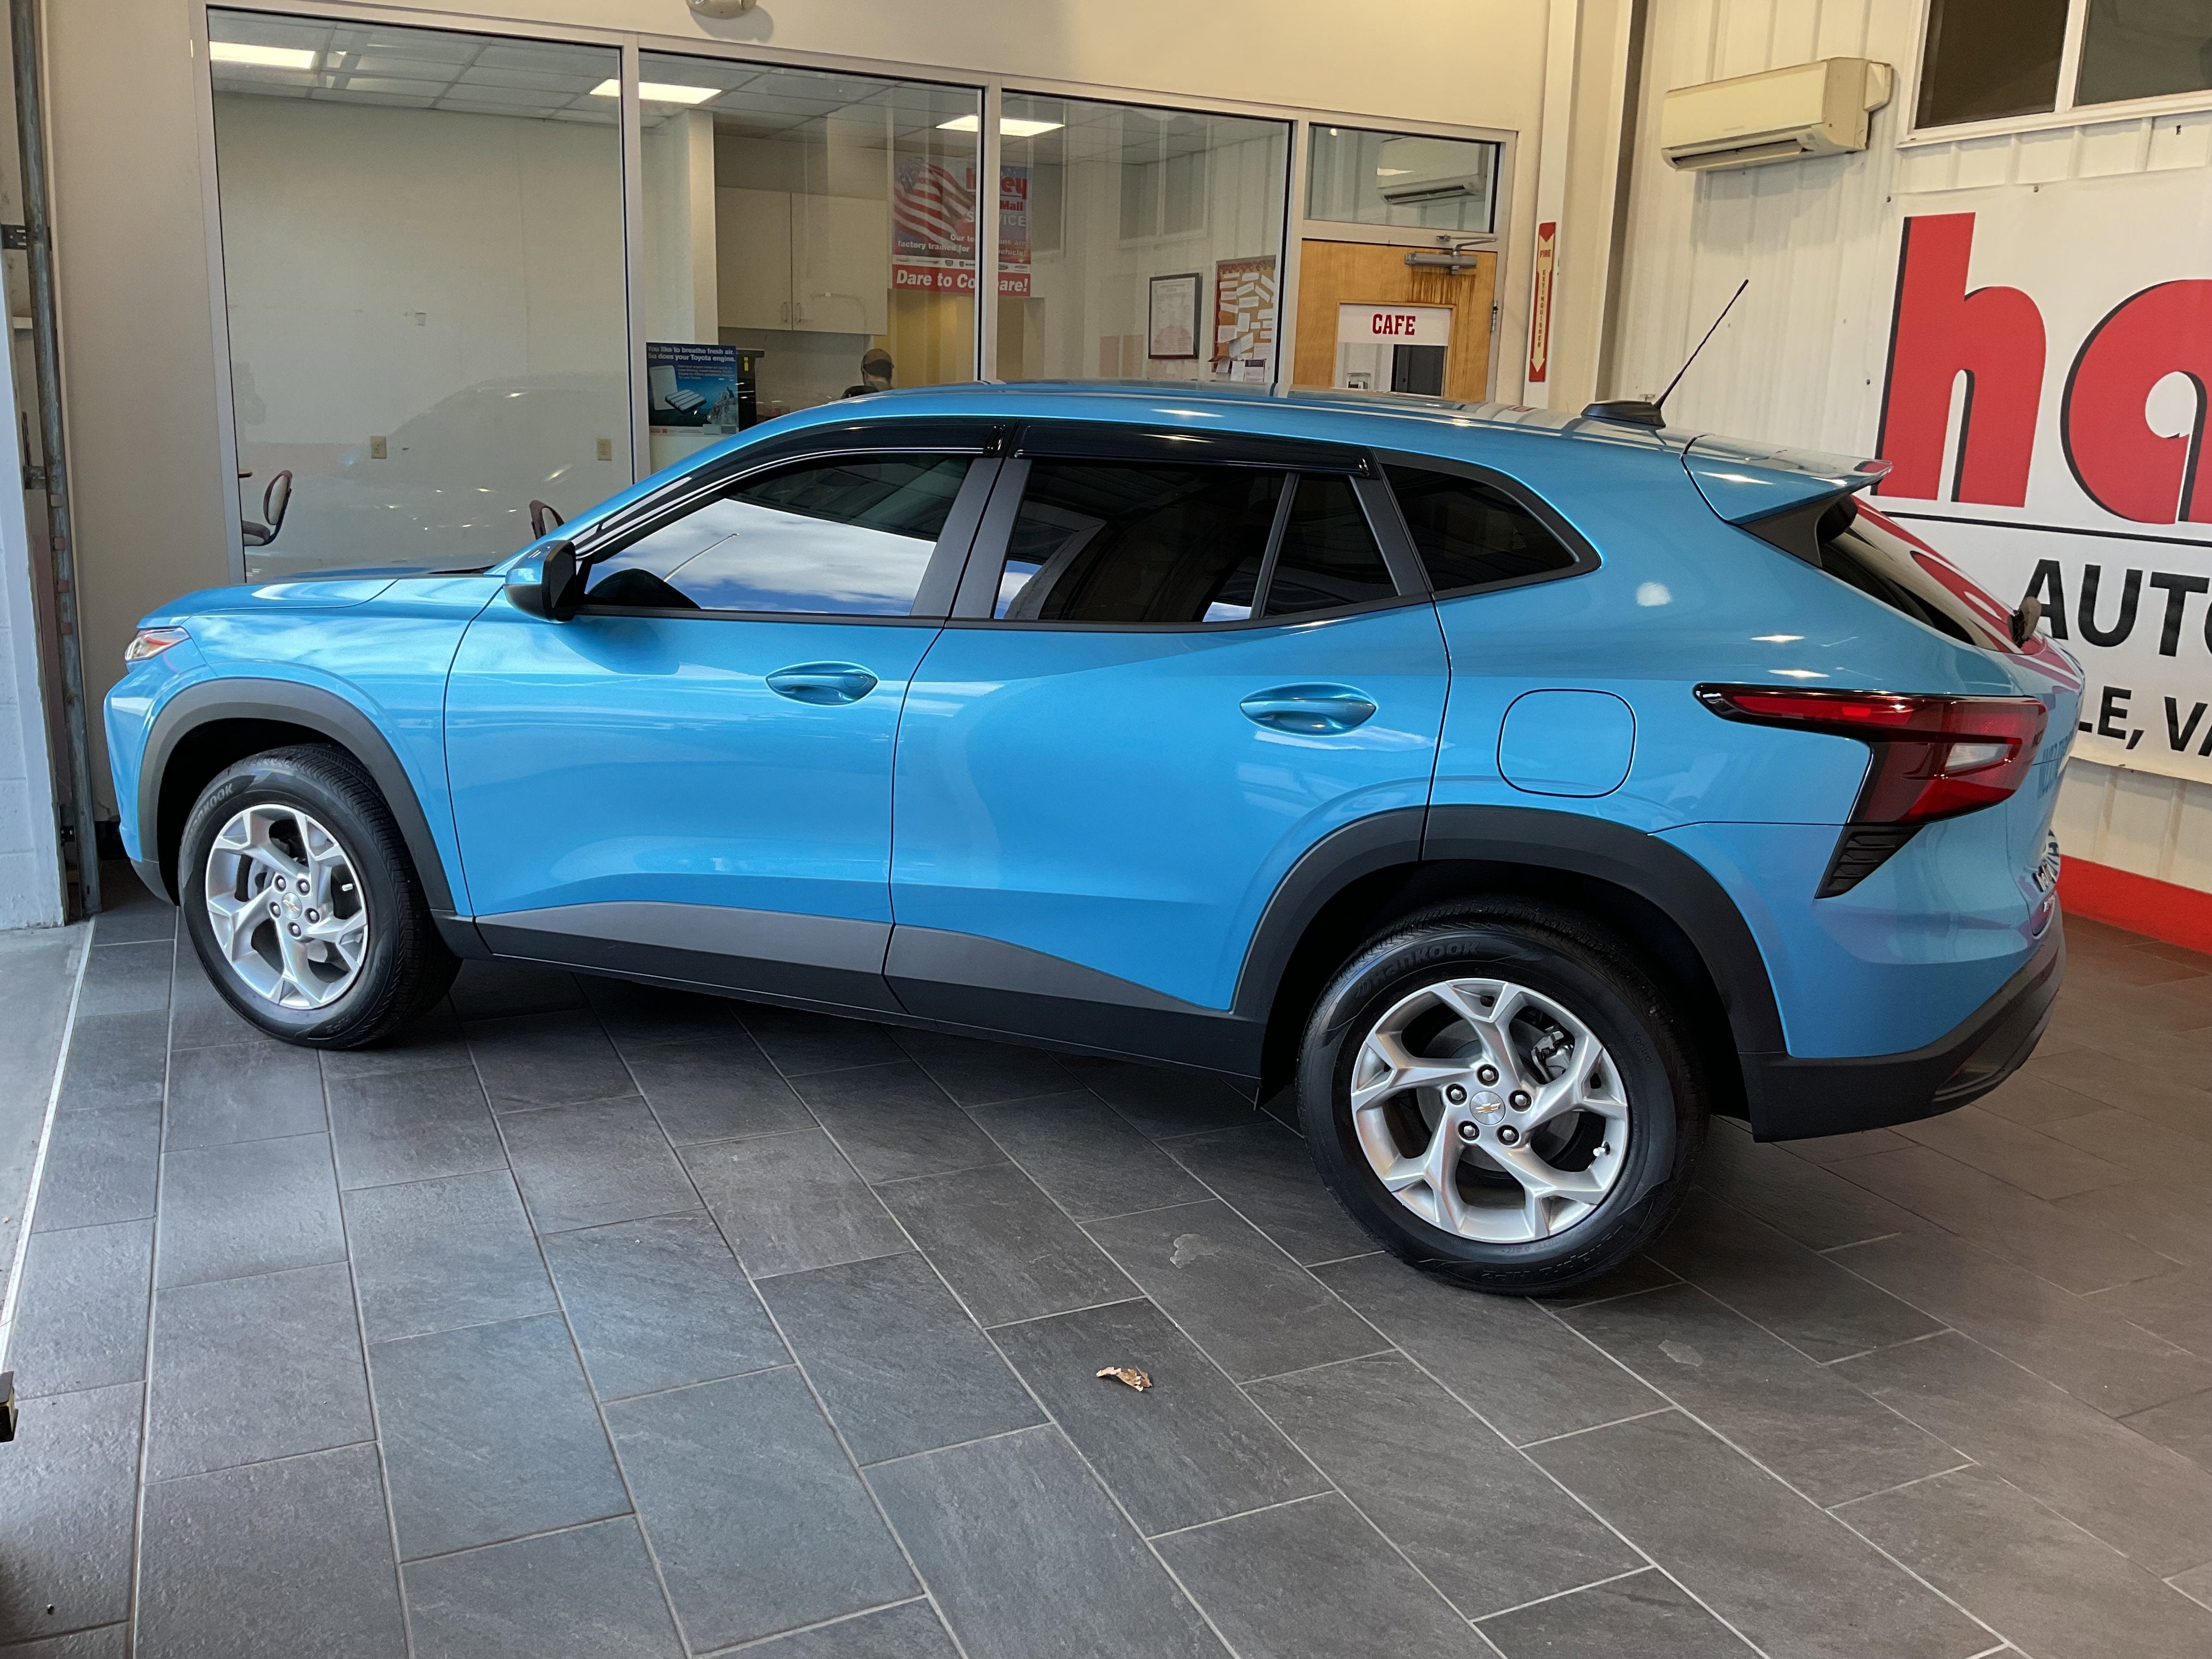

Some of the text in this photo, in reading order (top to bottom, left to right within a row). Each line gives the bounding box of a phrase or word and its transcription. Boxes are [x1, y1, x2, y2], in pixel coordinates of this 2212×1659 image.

[966, 166, 1028, 200] hey
[965, 210, 1026, 227] SICE
[898, 240, 926, 250] factory
[928, 242, 957, 251] trained
[959, 245, 970, 253] for
[896, 269, 1029, 292] Dare to Coare!
[1537, 249, 1551, 348] FIRE EXTINGUISHER
[1372, 313, 1416, 335] CAFE
[690, 354, 712, 362] Toyota
[2021, 558, 2212, 657] AUT
